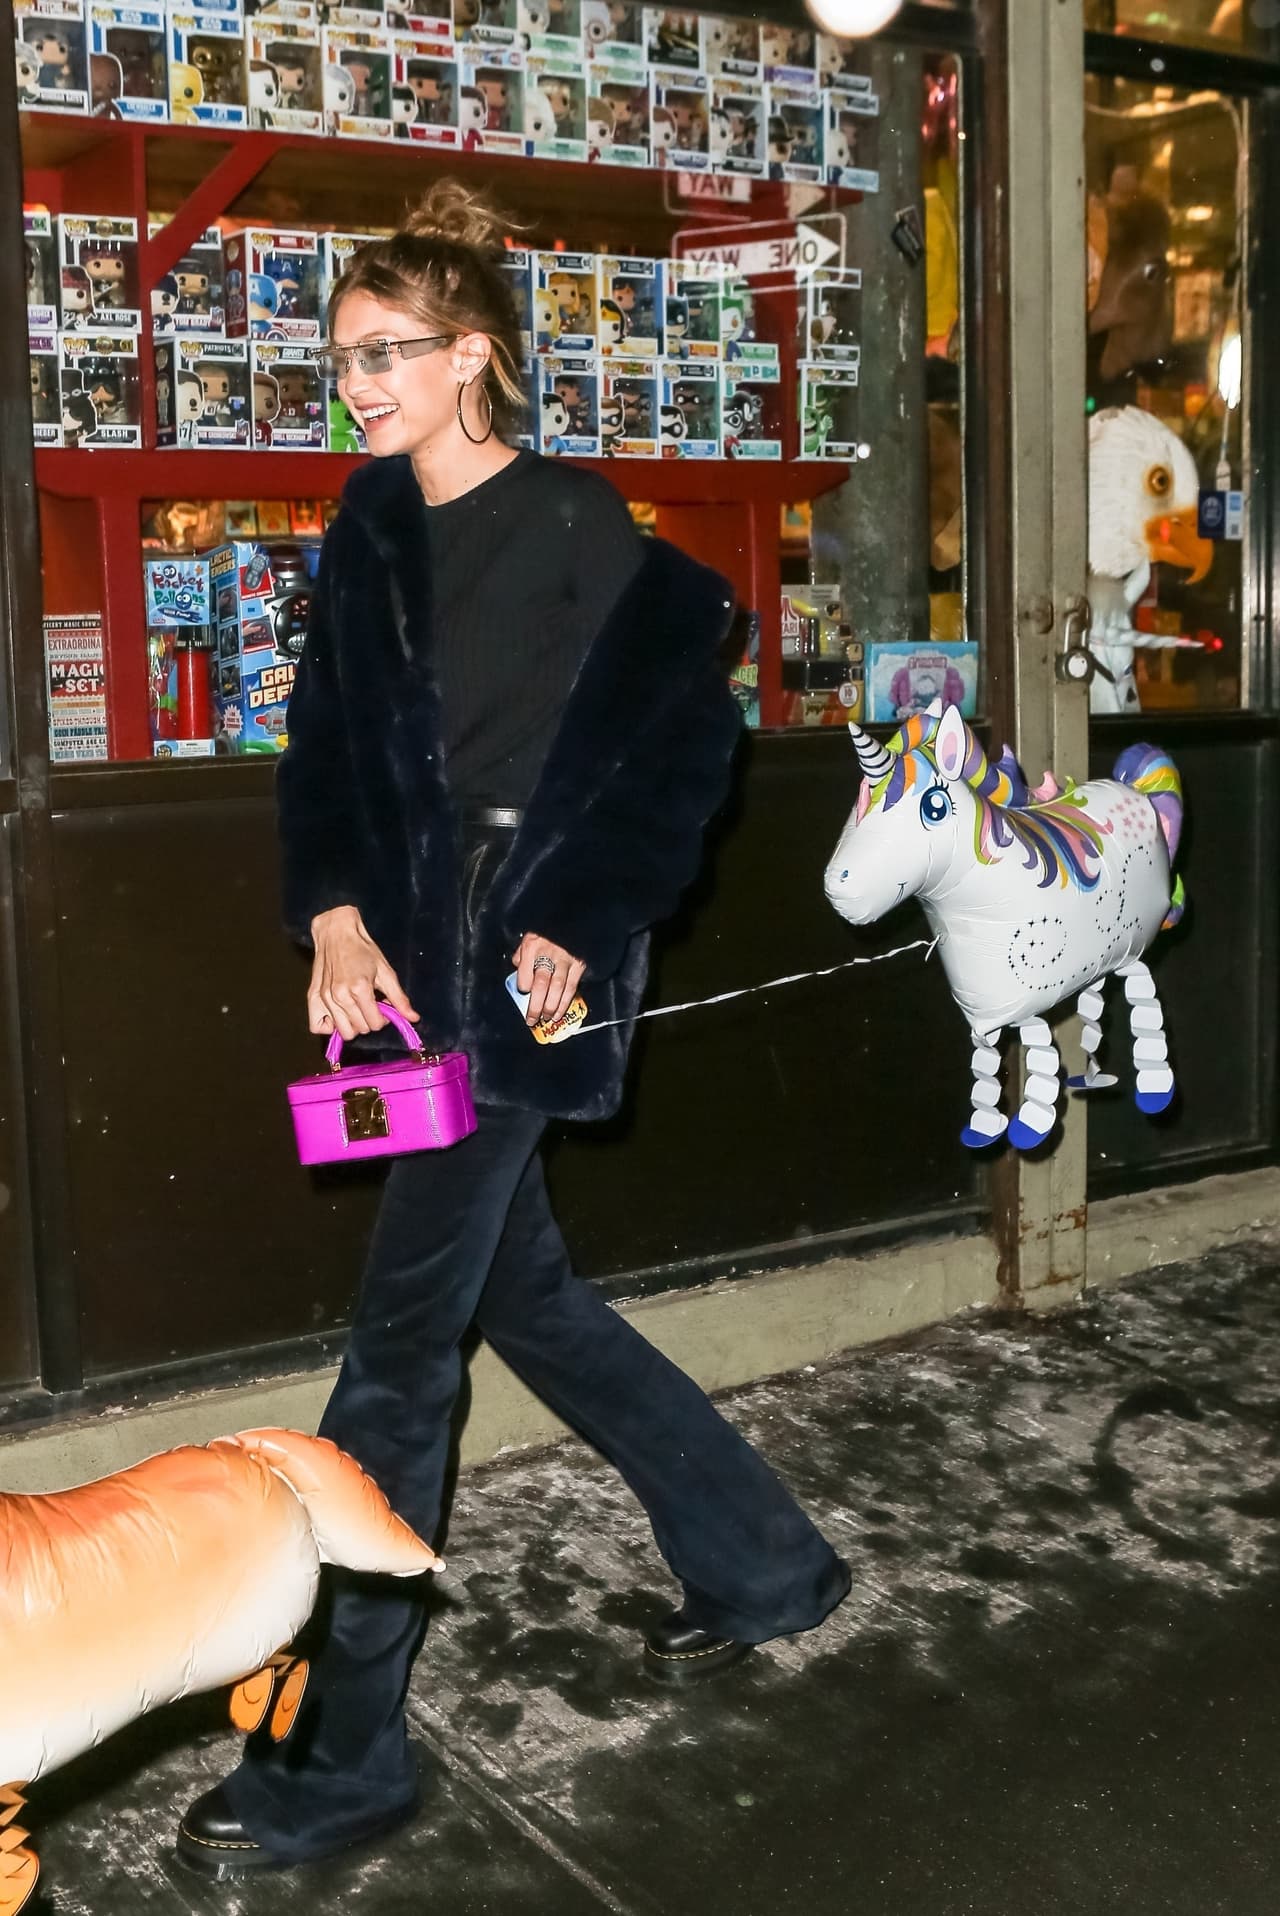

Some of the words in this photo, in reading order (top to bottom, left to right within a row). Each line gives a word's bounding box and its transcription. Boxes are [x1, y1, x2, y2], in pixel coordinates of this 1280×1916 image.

[100, 312, 113, 321] AXL
[115, 313, 132, 322] ROSE
[204, 344, 231, 353] PATRIOTS
[101, 429, 128, 438] SLASH
[152, 571, 204, 593] Rocket
[65, 678, 99, 693] SET
[250, 682, 294, 708] DEF
